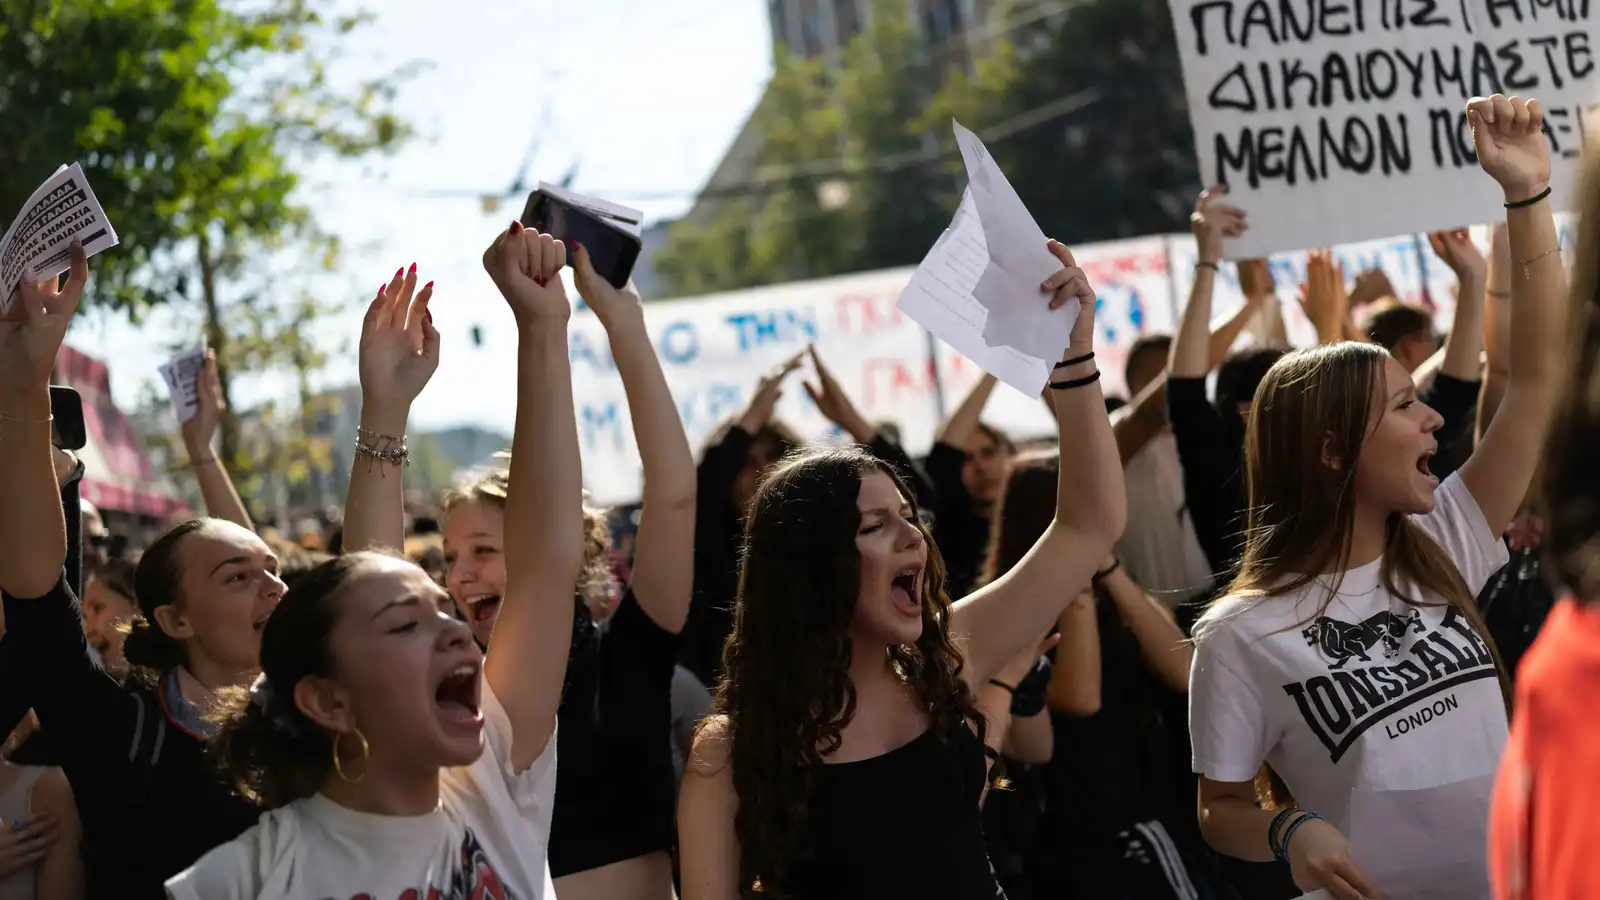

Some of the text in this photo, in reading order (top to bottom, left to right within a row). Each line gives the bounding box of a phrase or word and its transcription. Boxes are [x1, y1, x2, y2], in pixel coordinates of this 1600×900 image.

[1208, 31, 1595, 111] ΔΙΚΑΙΟΥΜΑΣΤΕ
[22, 222, 41, 240] ΤΗΝ
[41, 194, 82, 224] ΓΑΛΛΙΑ
[30, 183, 73, 218] ΕΛΛΑΔΑ
[41, 206, 92, 240] ΔΗΜΟΣΙΑ
[48, 215, 96, 247] ΠΑΙΔΕΙΑ!
[1385, 694, 1459, 740] LONDON
